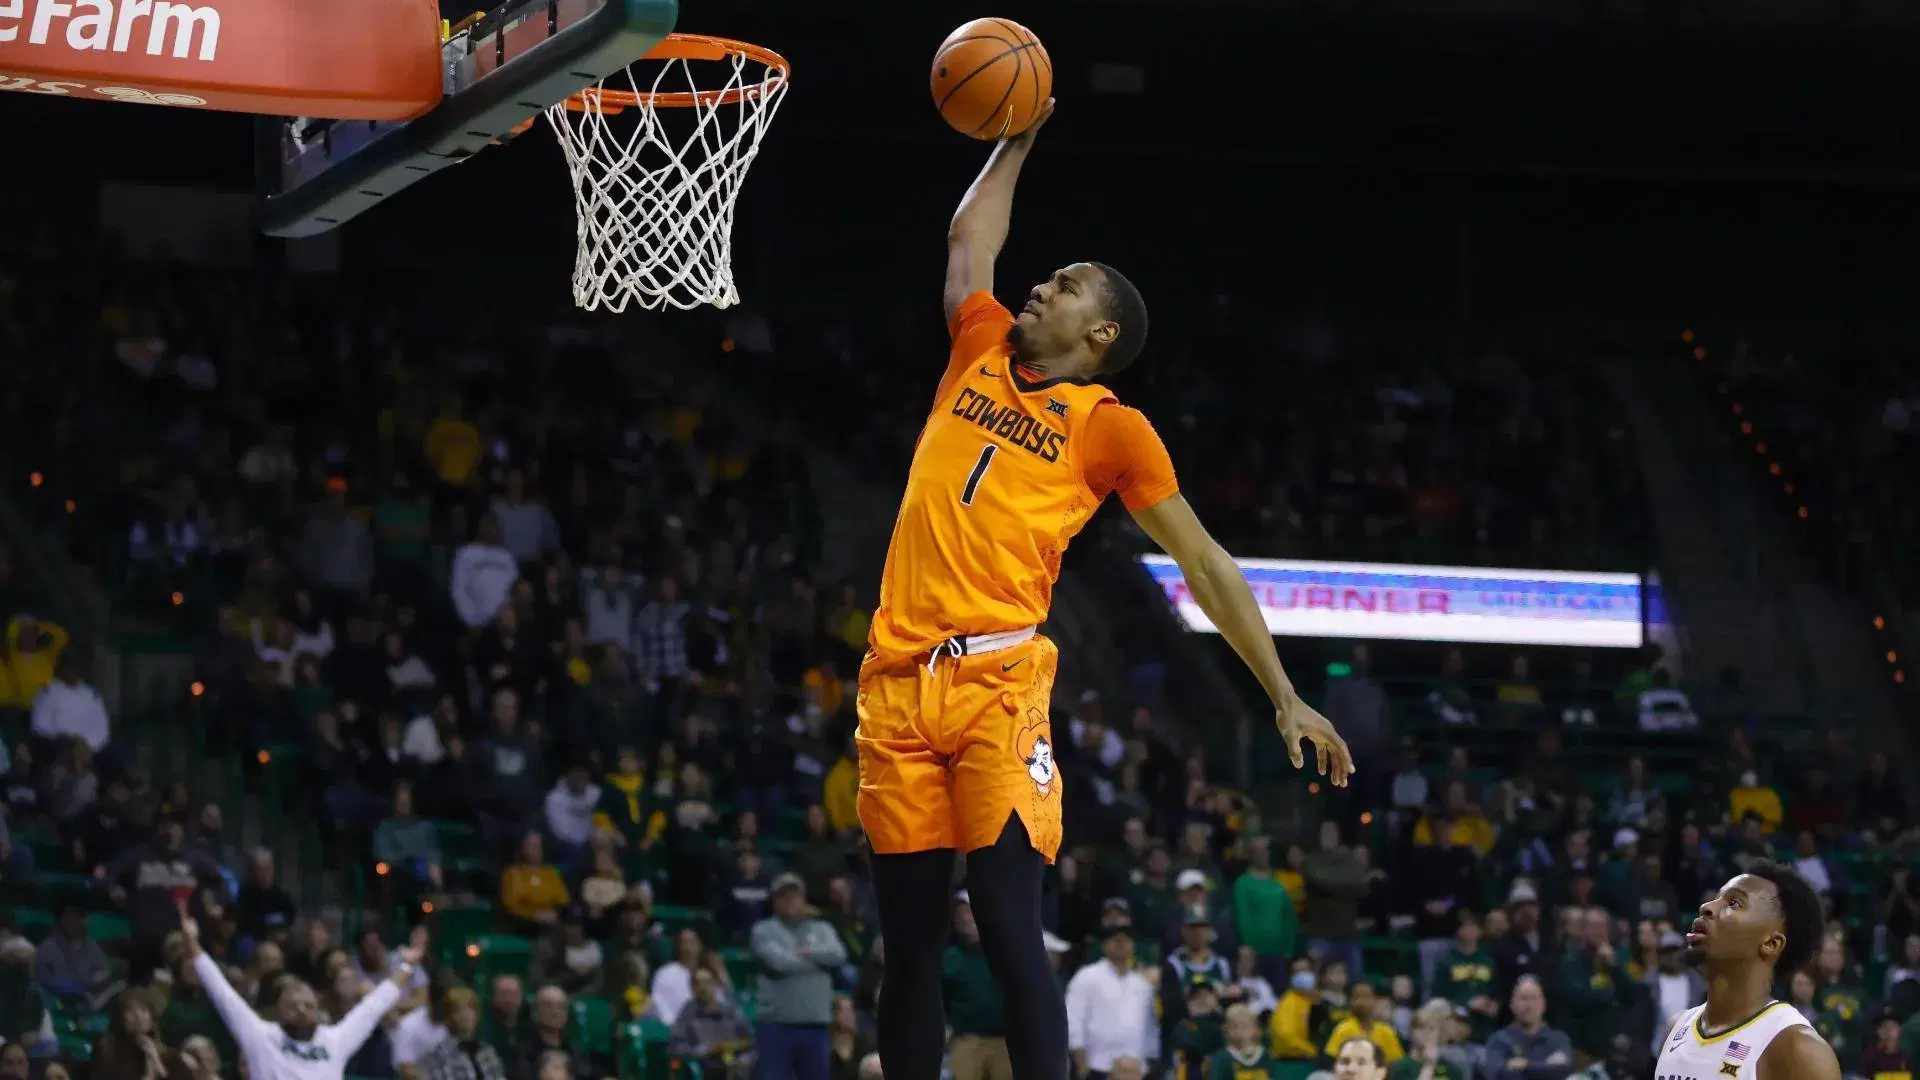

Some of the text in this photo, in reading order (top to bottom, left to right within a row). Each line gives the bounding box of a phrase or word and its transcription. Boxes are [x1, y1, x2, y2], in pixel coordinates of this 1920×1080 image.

[952, 387, 1066, 464] COWBOYS
[960, 443, 998, 507] 1
[1251, 583, 1452, 615] URNER
